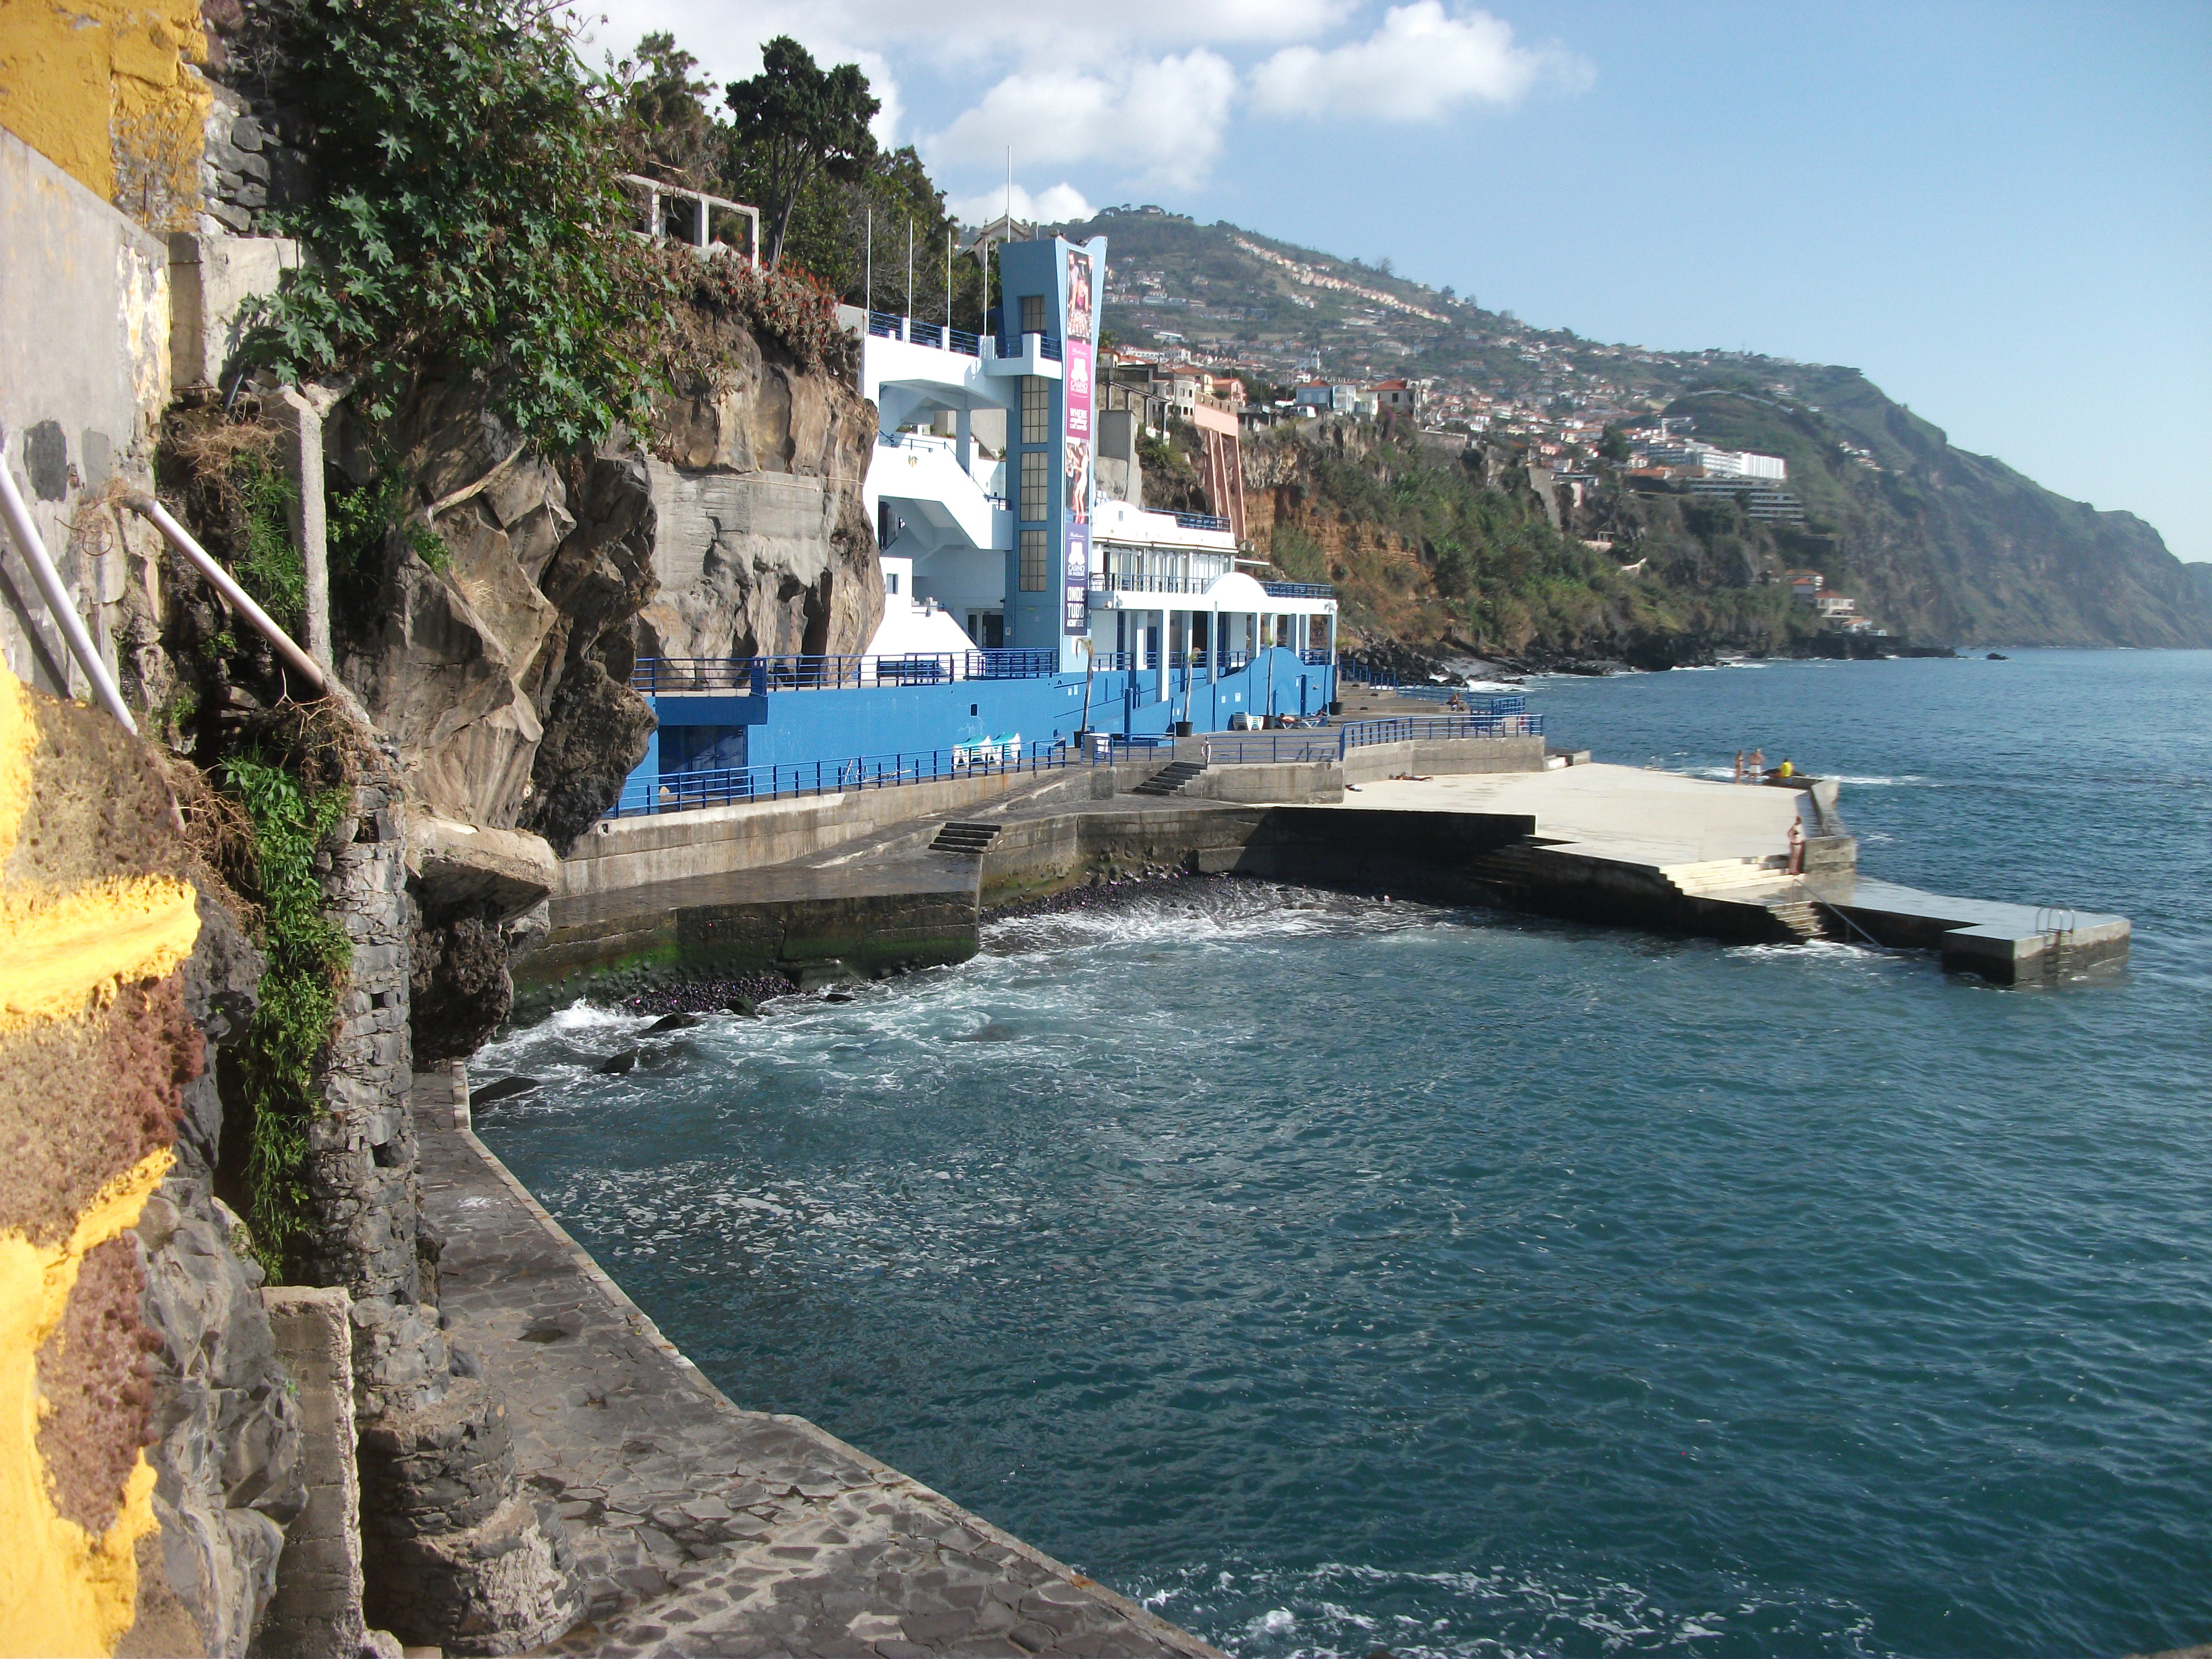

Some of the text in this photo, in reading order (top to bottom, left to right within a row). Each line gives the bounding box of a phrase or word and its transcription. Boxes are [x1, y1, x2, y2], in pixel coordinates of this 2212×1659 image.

[1070, 408, 1087, 419] WHERE
[1068, 564, 1085, 572] CASINO
[1067, 586, 1084, 602] ONDE
[1067, 603, 1084, 618] TUDO
